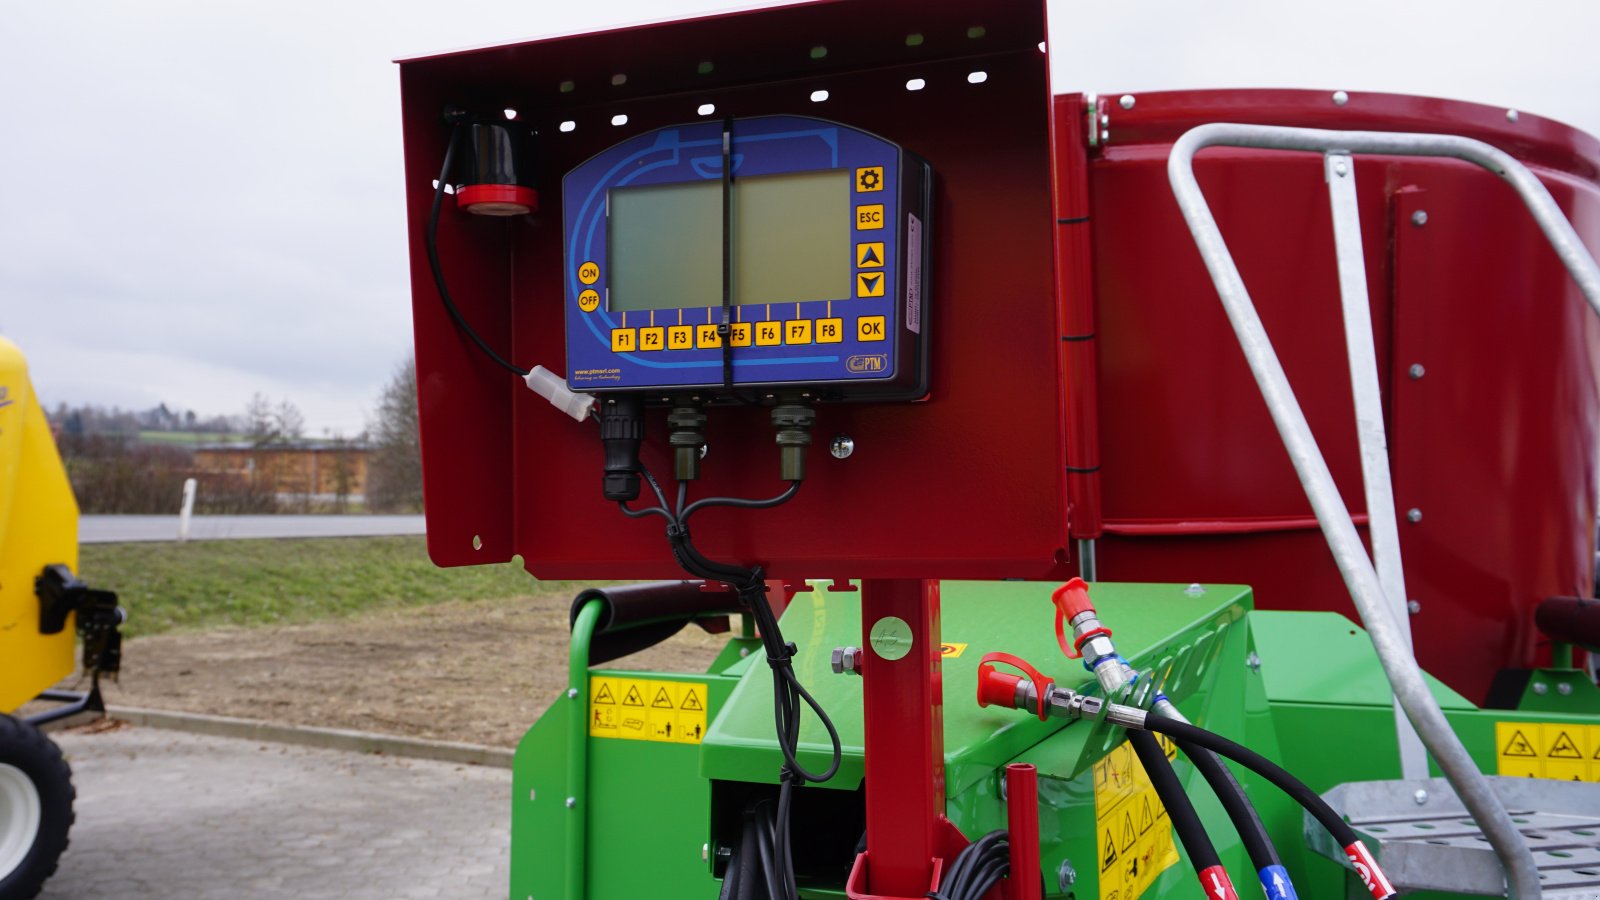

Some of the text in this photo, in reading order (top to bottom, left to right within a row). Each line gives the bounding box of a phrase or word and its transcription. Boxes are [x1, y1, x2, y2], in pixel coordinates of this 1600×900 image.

[860, 211, 880, 223] ESC
[582, 268, 596, 278] ON
[580, 296, 597, 305] OFF
[861, 322, 881, 335] OK
[618, 324, 835, 346] F1 F2 F3 F4 F5 F6 F7 F8
